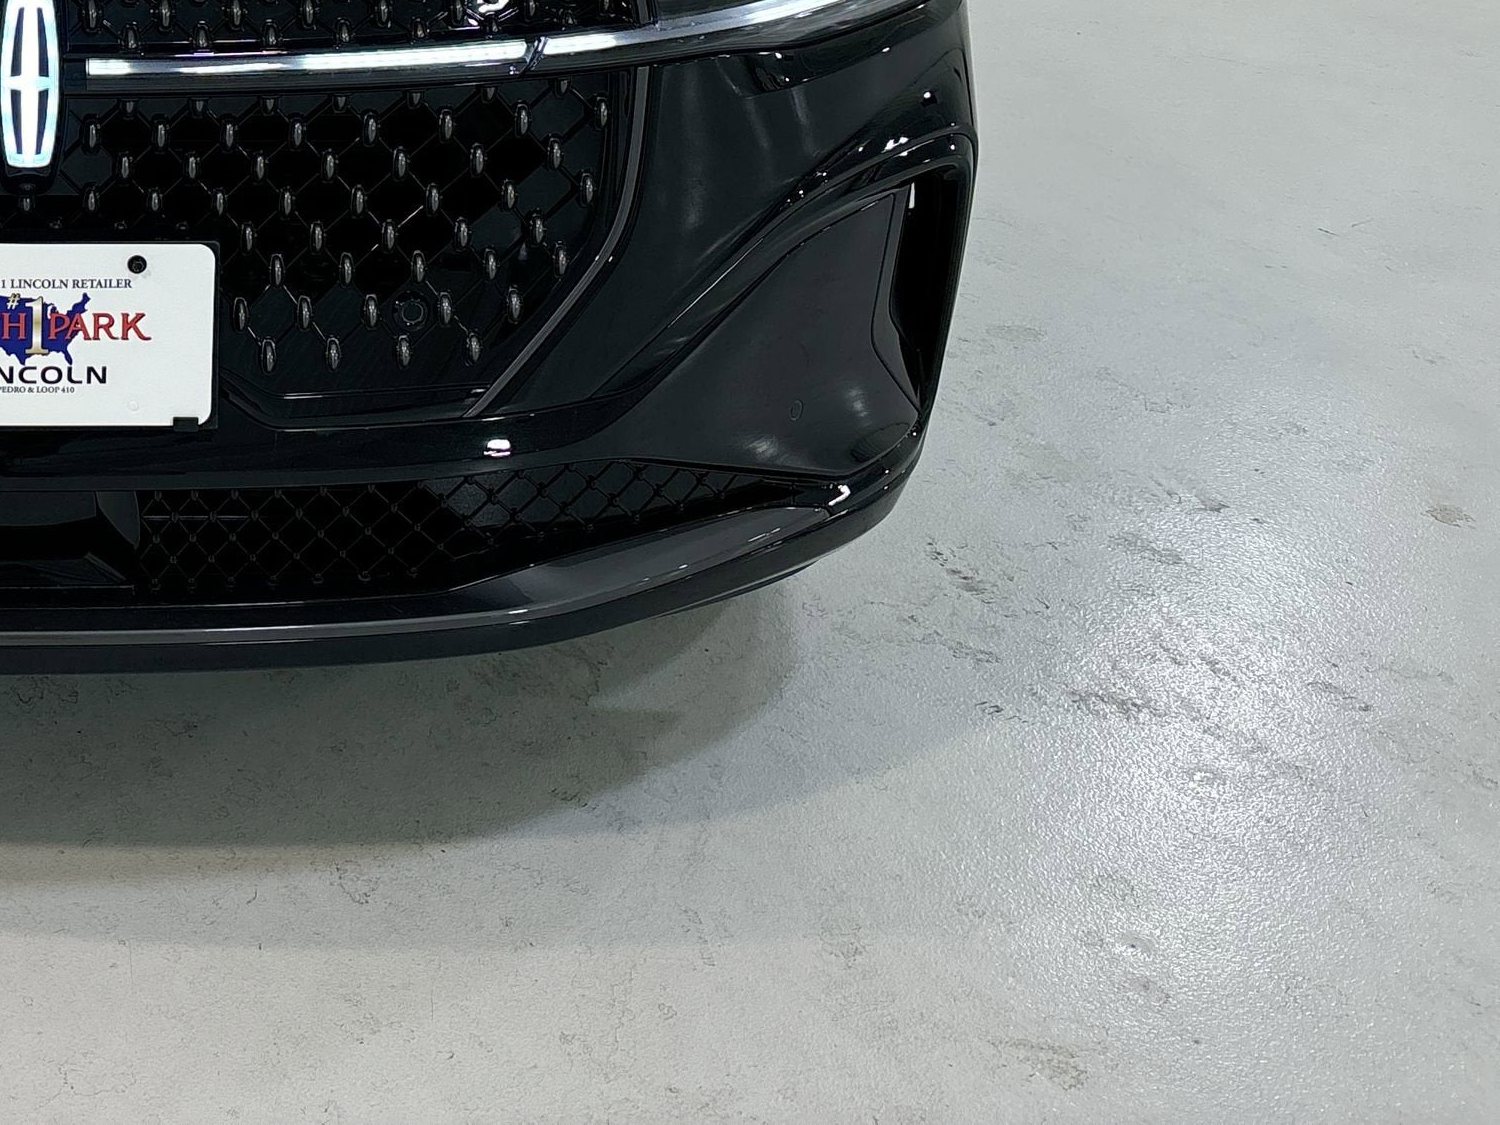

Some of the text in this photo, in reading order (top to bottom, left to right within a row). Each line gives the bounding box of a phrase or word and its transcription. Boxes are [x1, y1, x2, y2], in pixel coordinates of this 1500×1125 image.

[10, 278, 69, 289] LINCOLN
[72, 278, 133, 289] RETAILER
[48, 312, 152, 341] PARK
[27, 386, 35, 394] &
[36, 386, 60, 394] LOOP
[61, 386, 75, 394] 410
